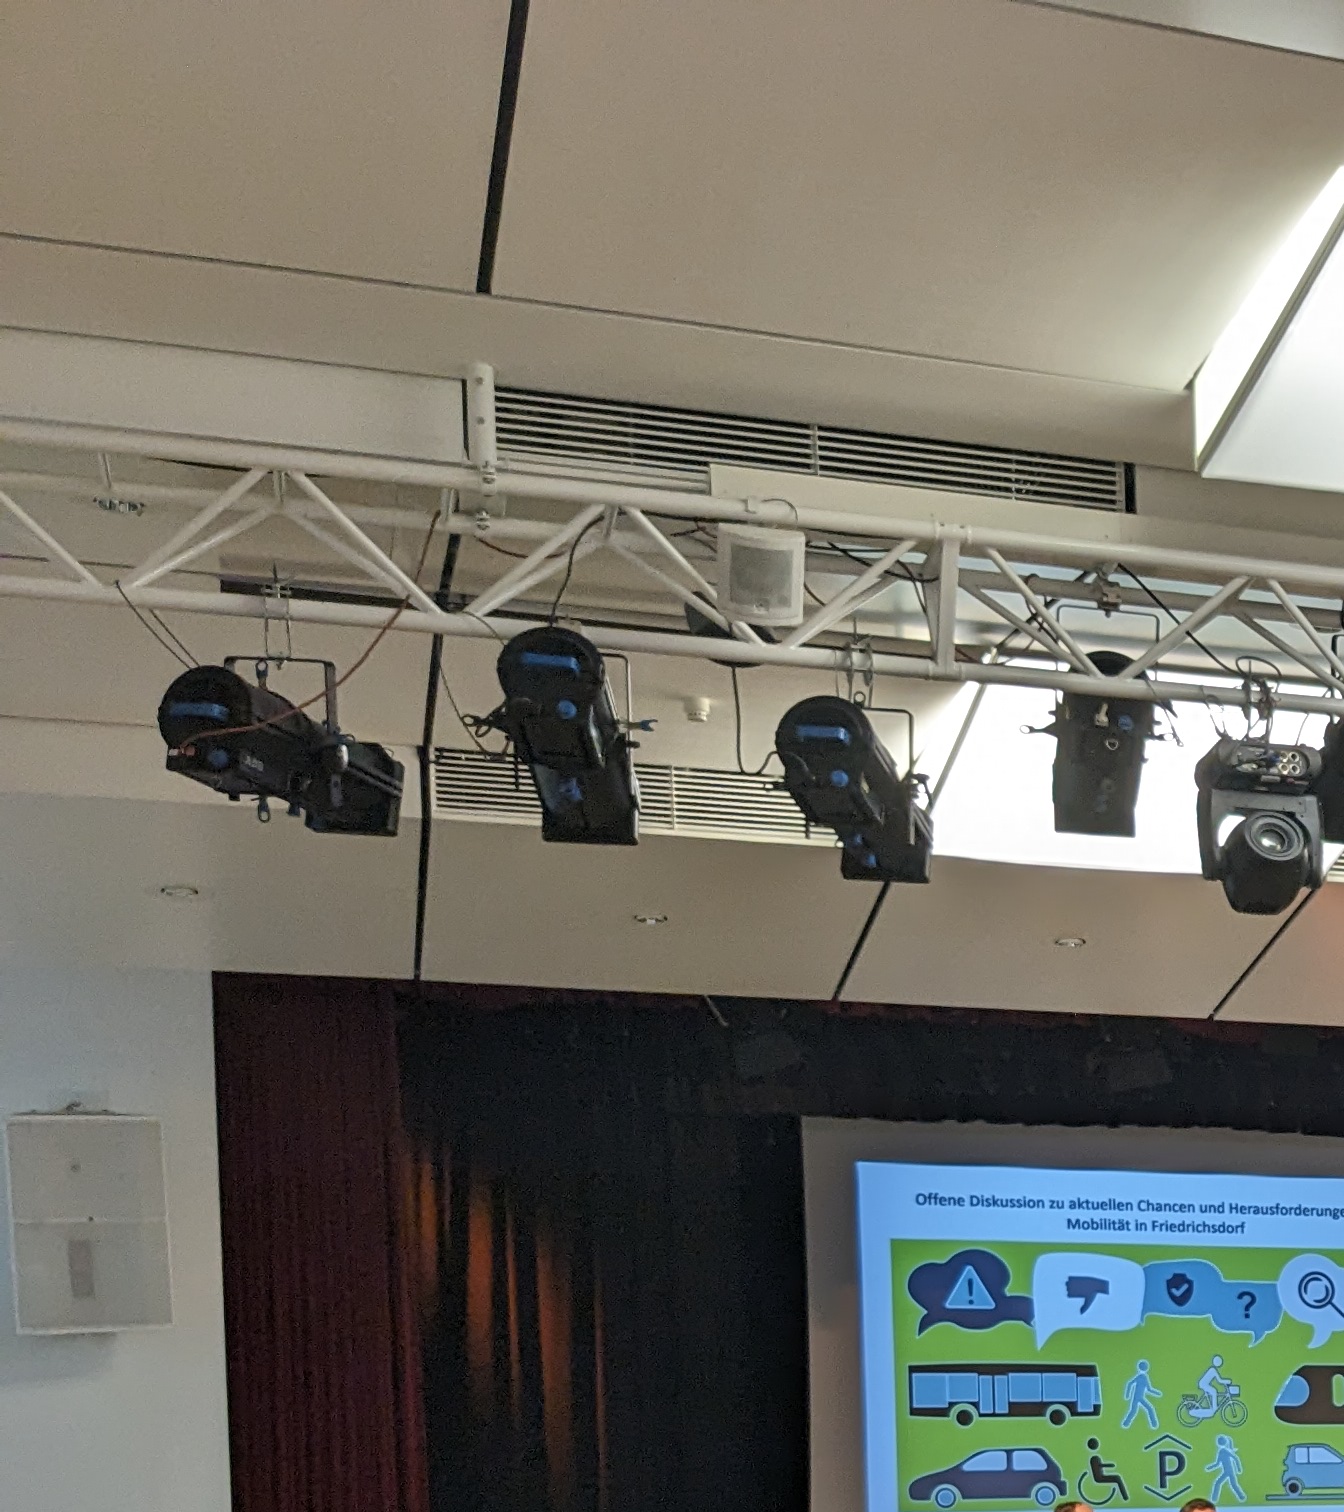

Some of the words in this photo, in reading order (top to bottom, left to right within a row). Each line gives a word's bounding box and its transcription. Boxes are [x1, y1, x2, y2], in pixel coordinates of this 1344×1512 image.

[914, 1192, 966, 1207] Offene
[969, 1194, 1046, 1210] Diskussion
[1049, 1199, 1065, 1210] zu
[1068, 1197, 1134, 1212] aktuellen
[1137, 1199, 1196, 1214] Chancen
[1199, 1202, 1225, 1215] und
[1066, 1217, 1132, 1232] Mobilität
[1134, 1219, 1148, 1232] in
[1151, 1219, 1247, 1235] Friedrichsdorf
[1158, 1450, 1186, 1489] P
